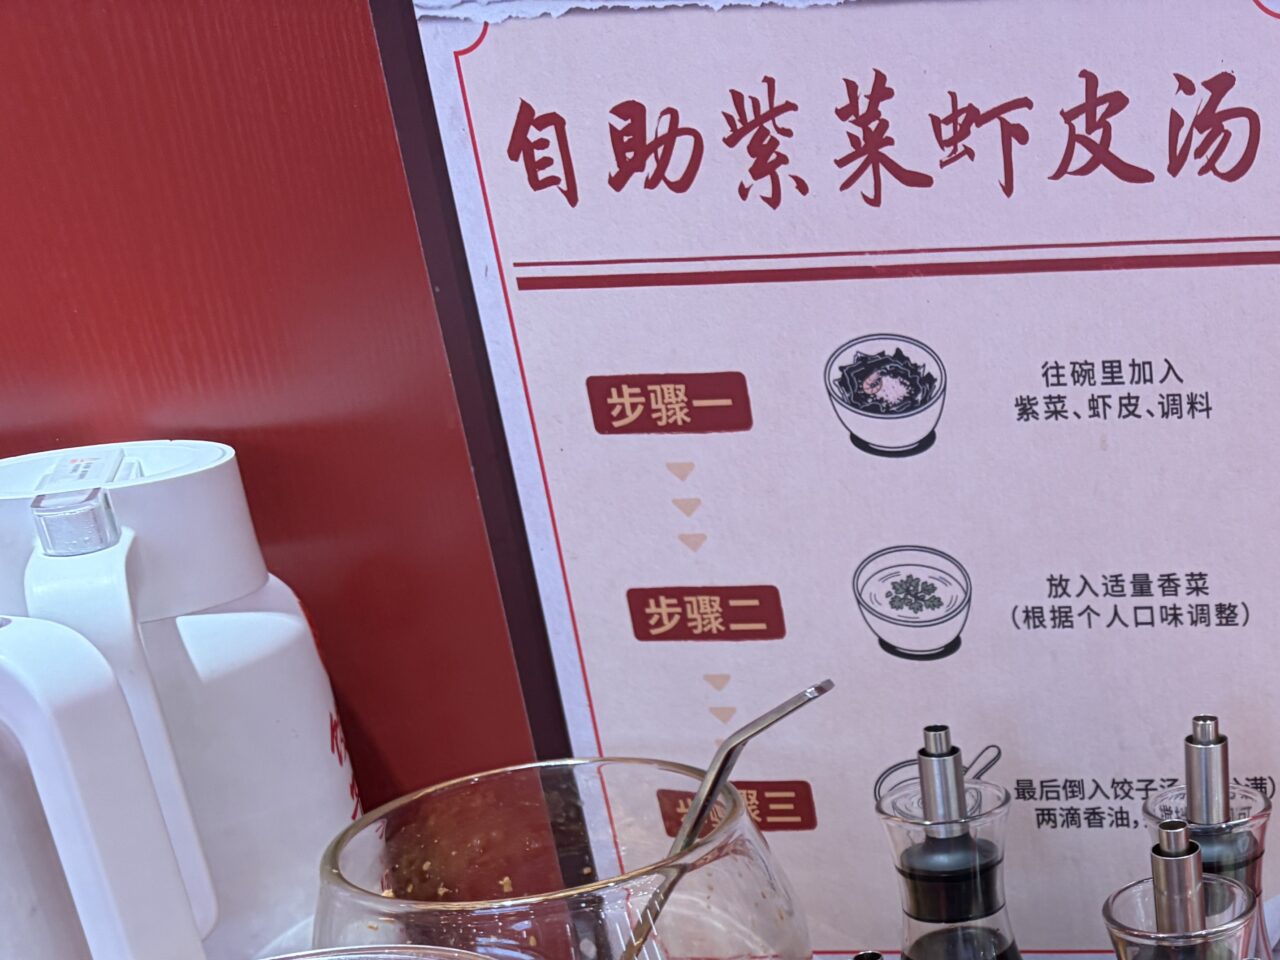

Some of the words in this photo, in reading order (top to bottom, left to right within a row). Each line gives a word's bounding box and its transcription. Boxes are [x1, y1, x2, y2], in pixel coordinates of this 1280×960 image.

[506, 68, 1262, 209] 自助紫菜虾皮汤
[1041, 358, 1184, 388] 往碗里加入
[606, 383, 733, 427] 步骤一
[1014, 392, 1213, 423] 紫菜、虾皮、调料
[1046, 572, 1210, 599] 放入适量香菜
[645, 595, 768, 636] 步骤二
[1010, 602, 1251, 630] (根据个人口味调整)
